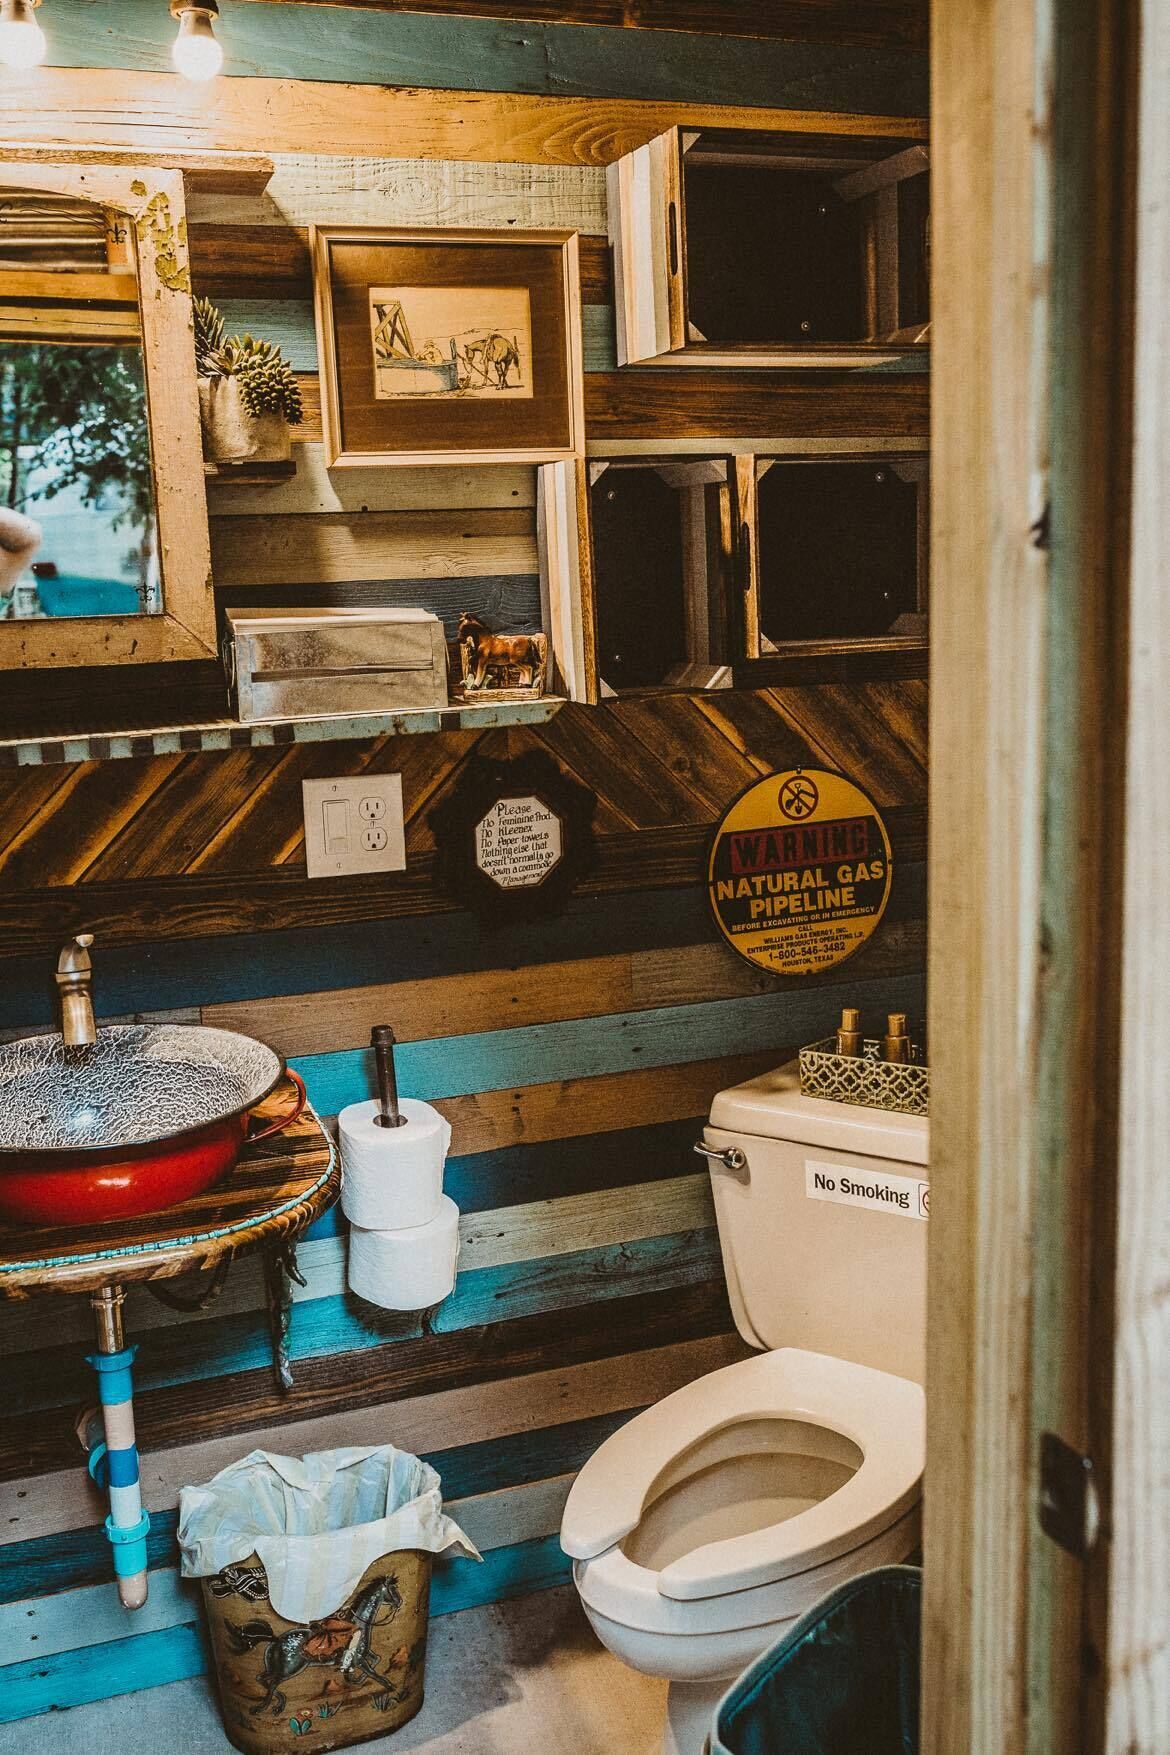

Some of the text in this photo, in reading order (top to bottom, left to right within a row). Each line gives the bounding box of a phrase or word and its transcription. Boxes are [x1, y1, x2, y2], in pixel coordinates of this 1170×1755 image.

[495, 802, 532, 817] Please
[482, 819, 495, 828] No
[498, 814, 534, 826] Feminine
[481, 825, 533, 838] No Kleenex
[481, 832, 550, 848] No Paper towels
[734, 820, 867, 868] WARNING
[481, 841, 547, 858] Nothing else that
[509, 851, 544, 865] normally
[545, 851, 554, 860] go
[490, 866, 511, 876] down
[518, 860, 552, 873] commode
[717, 860, 884, 901] NATURAL GAS
[750, 886, 856, 919] PIPELINE
[732, 922, 760, 932] BEFORE
[763, 915, 808, 928] EXCAVATING
[832, 906, 875, 918] EMERGENCY
[798, 924, 813, 932] CALL
[747, 943, 784, 954] ENTERPRISE
[786, 939, 818, 948] PRODUCTS
[820, 934, 853, 944] OPERATING
[763, 934, 794, 944] WILLIAMS
[814, 954, 834, 963] TEXAS
[814, 1173, 910, 1209] No Smoking
